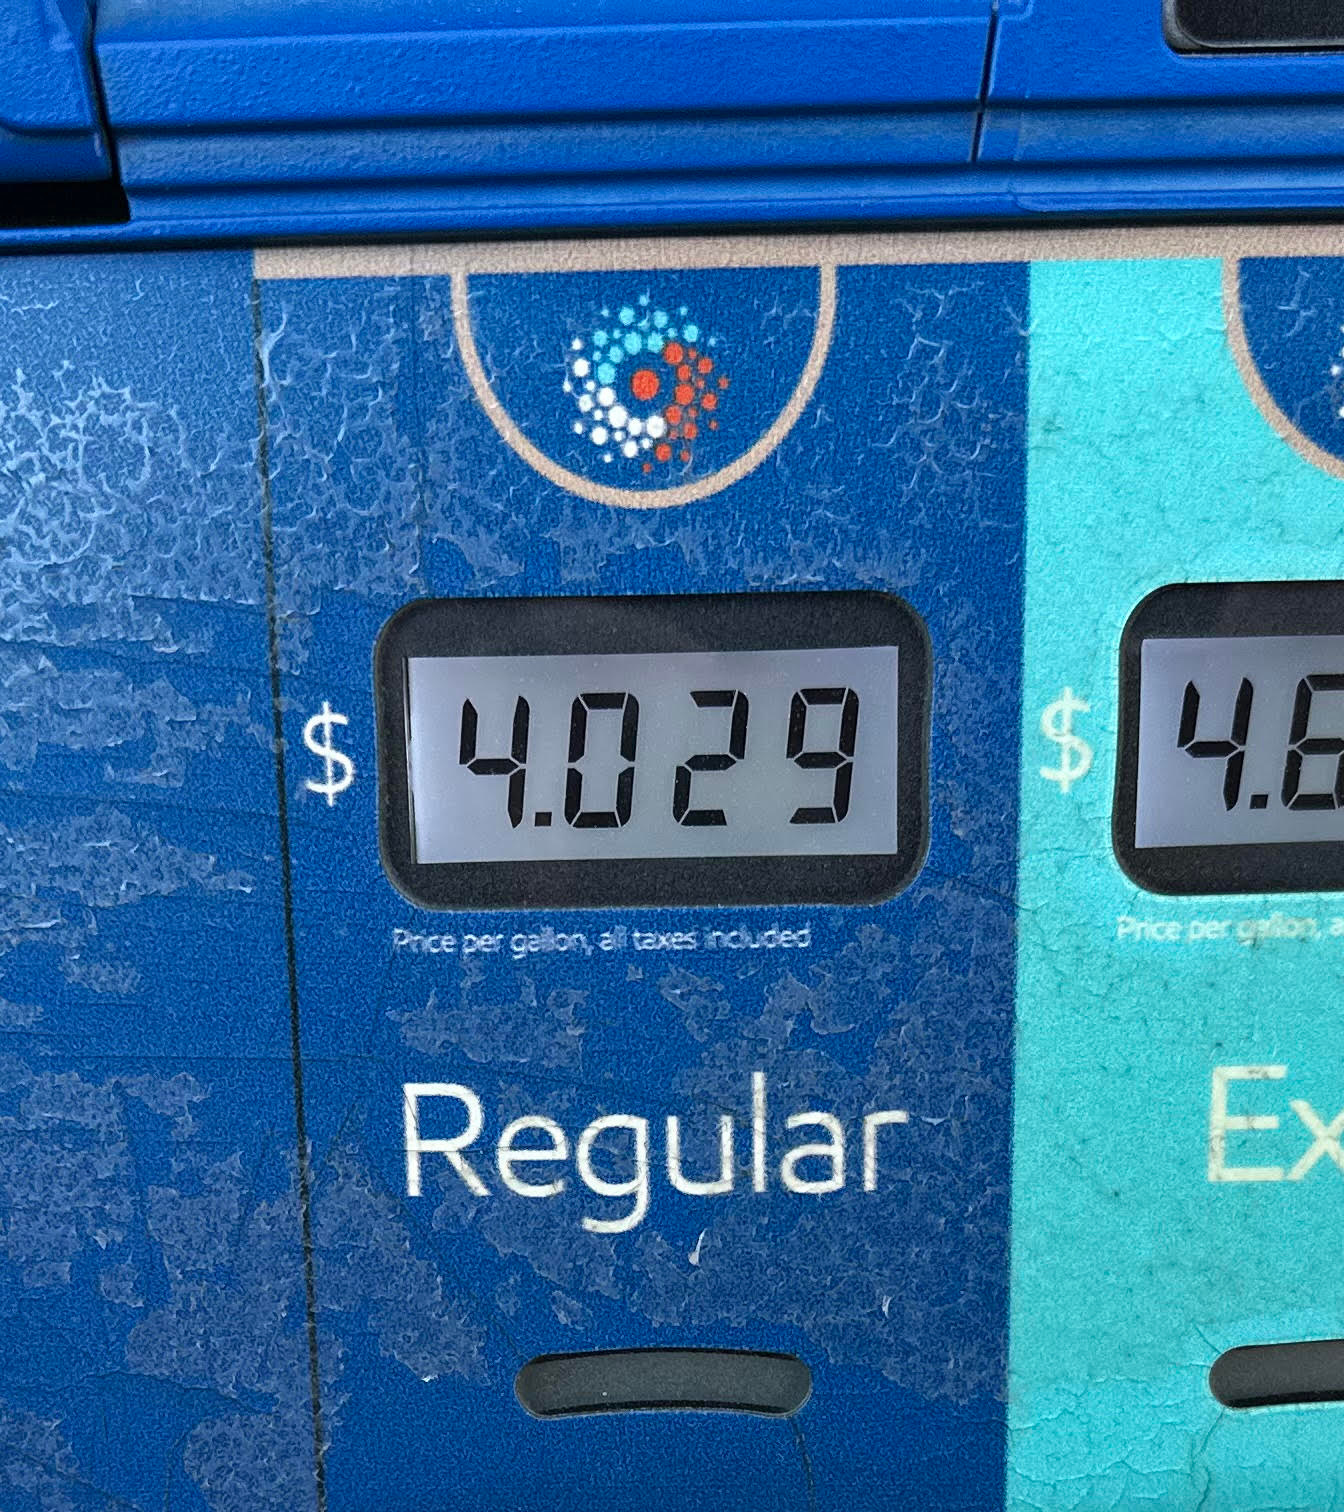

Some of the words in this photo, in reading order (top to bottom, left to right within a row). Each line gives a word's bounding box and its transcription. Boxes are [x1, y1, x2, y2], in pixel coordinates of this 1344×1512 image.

[303, 701, 354, 805] $
[459, 686, 860, 830] 4.029
[1040, 686, 1093, 792] $
[393, 927, 455, 954] Price
[461, 930, 503, 958] per
[634, 927, 697, 951] taxes
[706, 923, 812, 950] included
[1117, 914, 1180, 941] Price
[1188, 917, 1231, 944] per
[1237, 911, 1321, 947] gallon,
[402, 1071, 909, 1233] Regular
